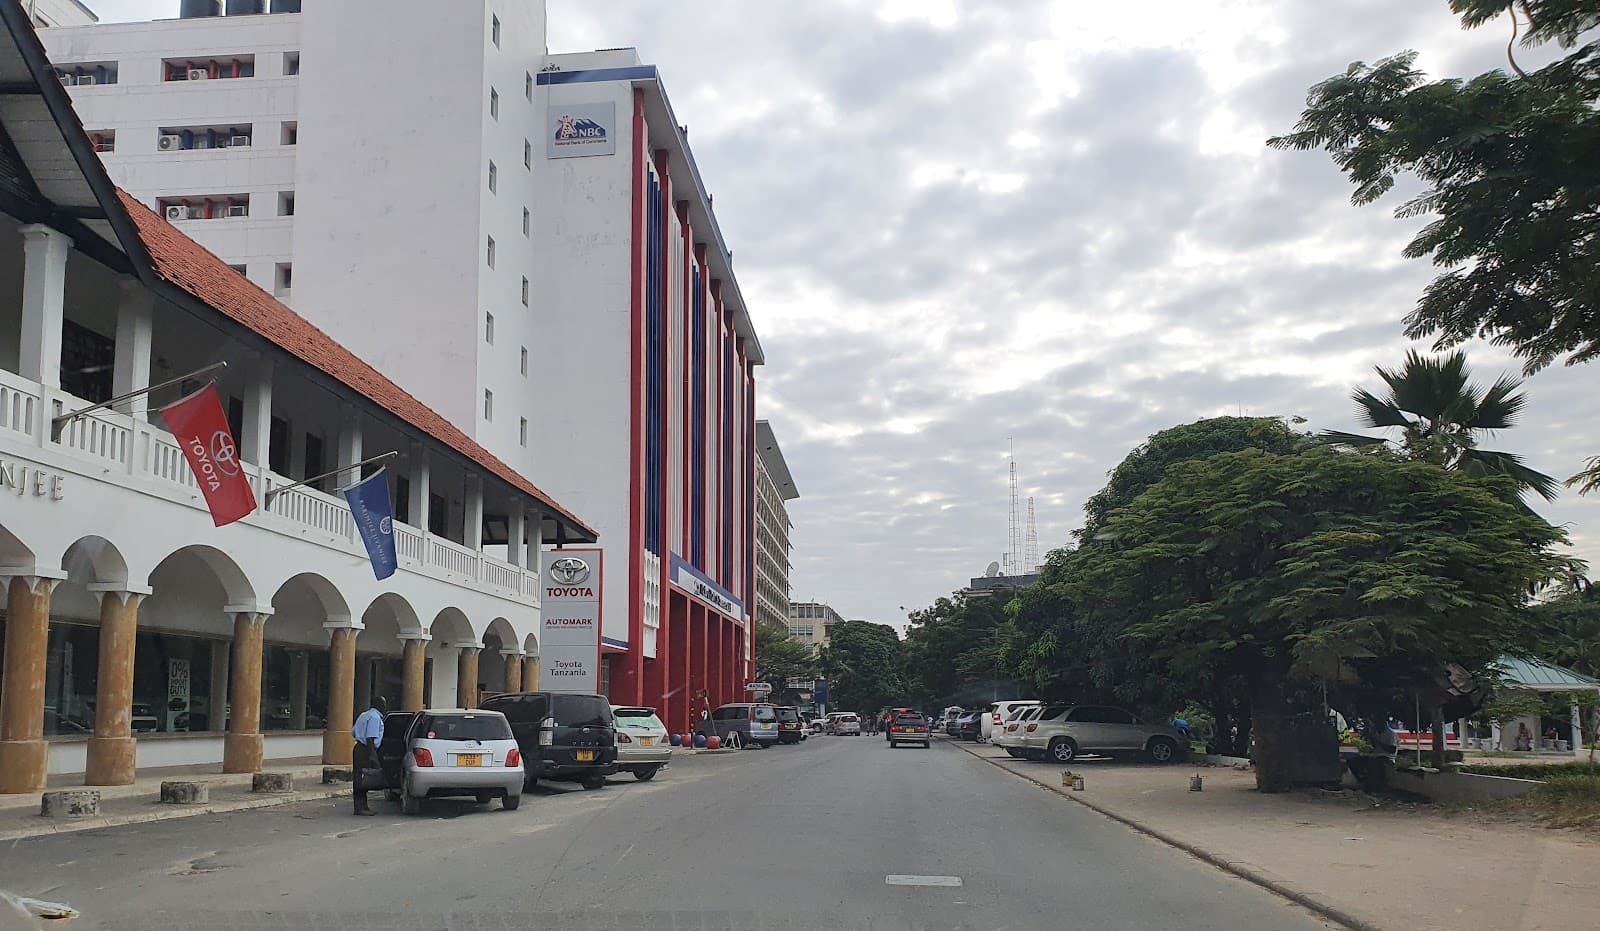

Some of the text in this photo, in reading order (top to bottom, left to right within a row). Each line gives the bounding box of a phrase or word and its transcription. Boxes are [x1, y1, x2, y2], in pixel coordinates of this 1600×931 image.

[579, 127, 601, 137] NBC
[190, 435, 220, 492] TOYOTA
[0, 460, 64, 501] NJEE
[546, 587, 593, 597] TOYOTA
[553, 660, 583, 669] Toyota
[171, 661, 188, 679] 0%
[550, 668, 587, 676] Tanzania
